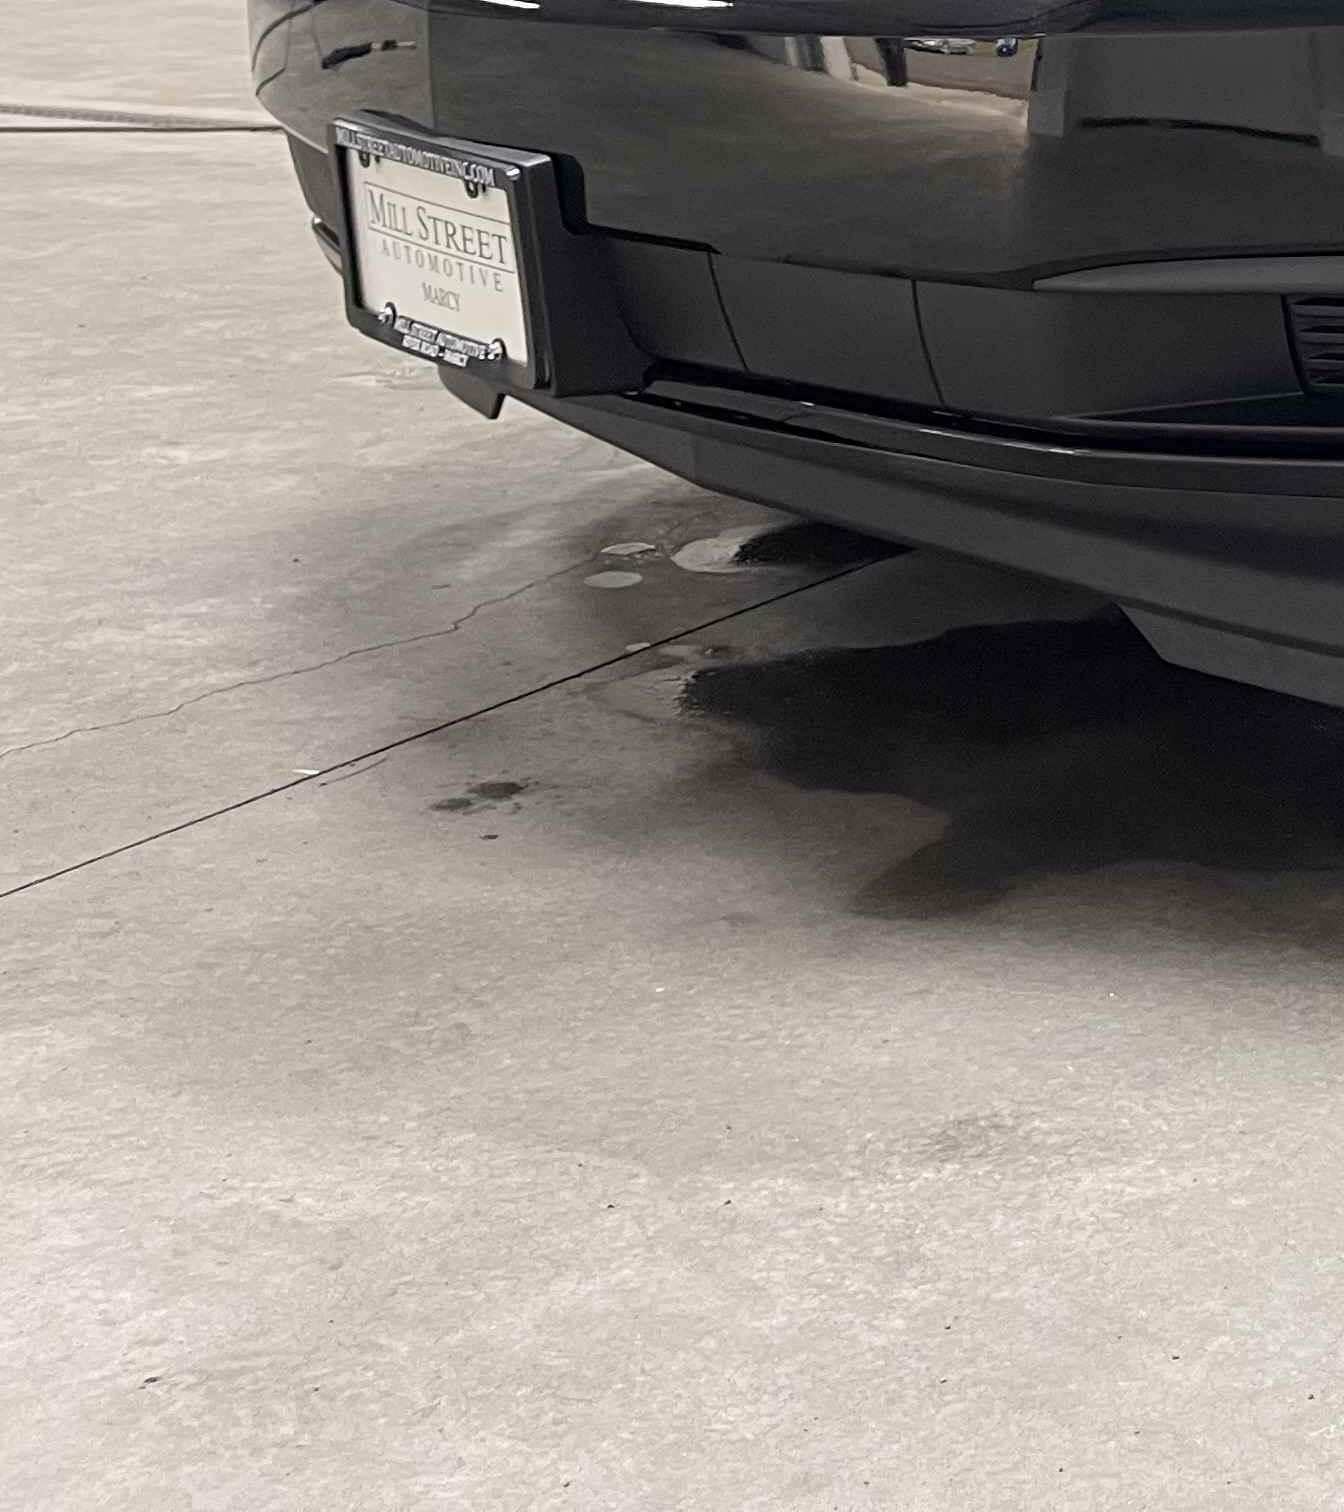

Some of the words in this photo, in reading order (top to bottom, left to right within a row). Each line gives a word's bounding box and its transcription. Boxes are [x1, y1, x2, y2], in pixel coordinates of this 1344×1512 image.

[367, 189, 413, 236] MILL
[416, 205, 507, 265] STREET
[381, 238, 504, 293] AUTOMOTIVE
